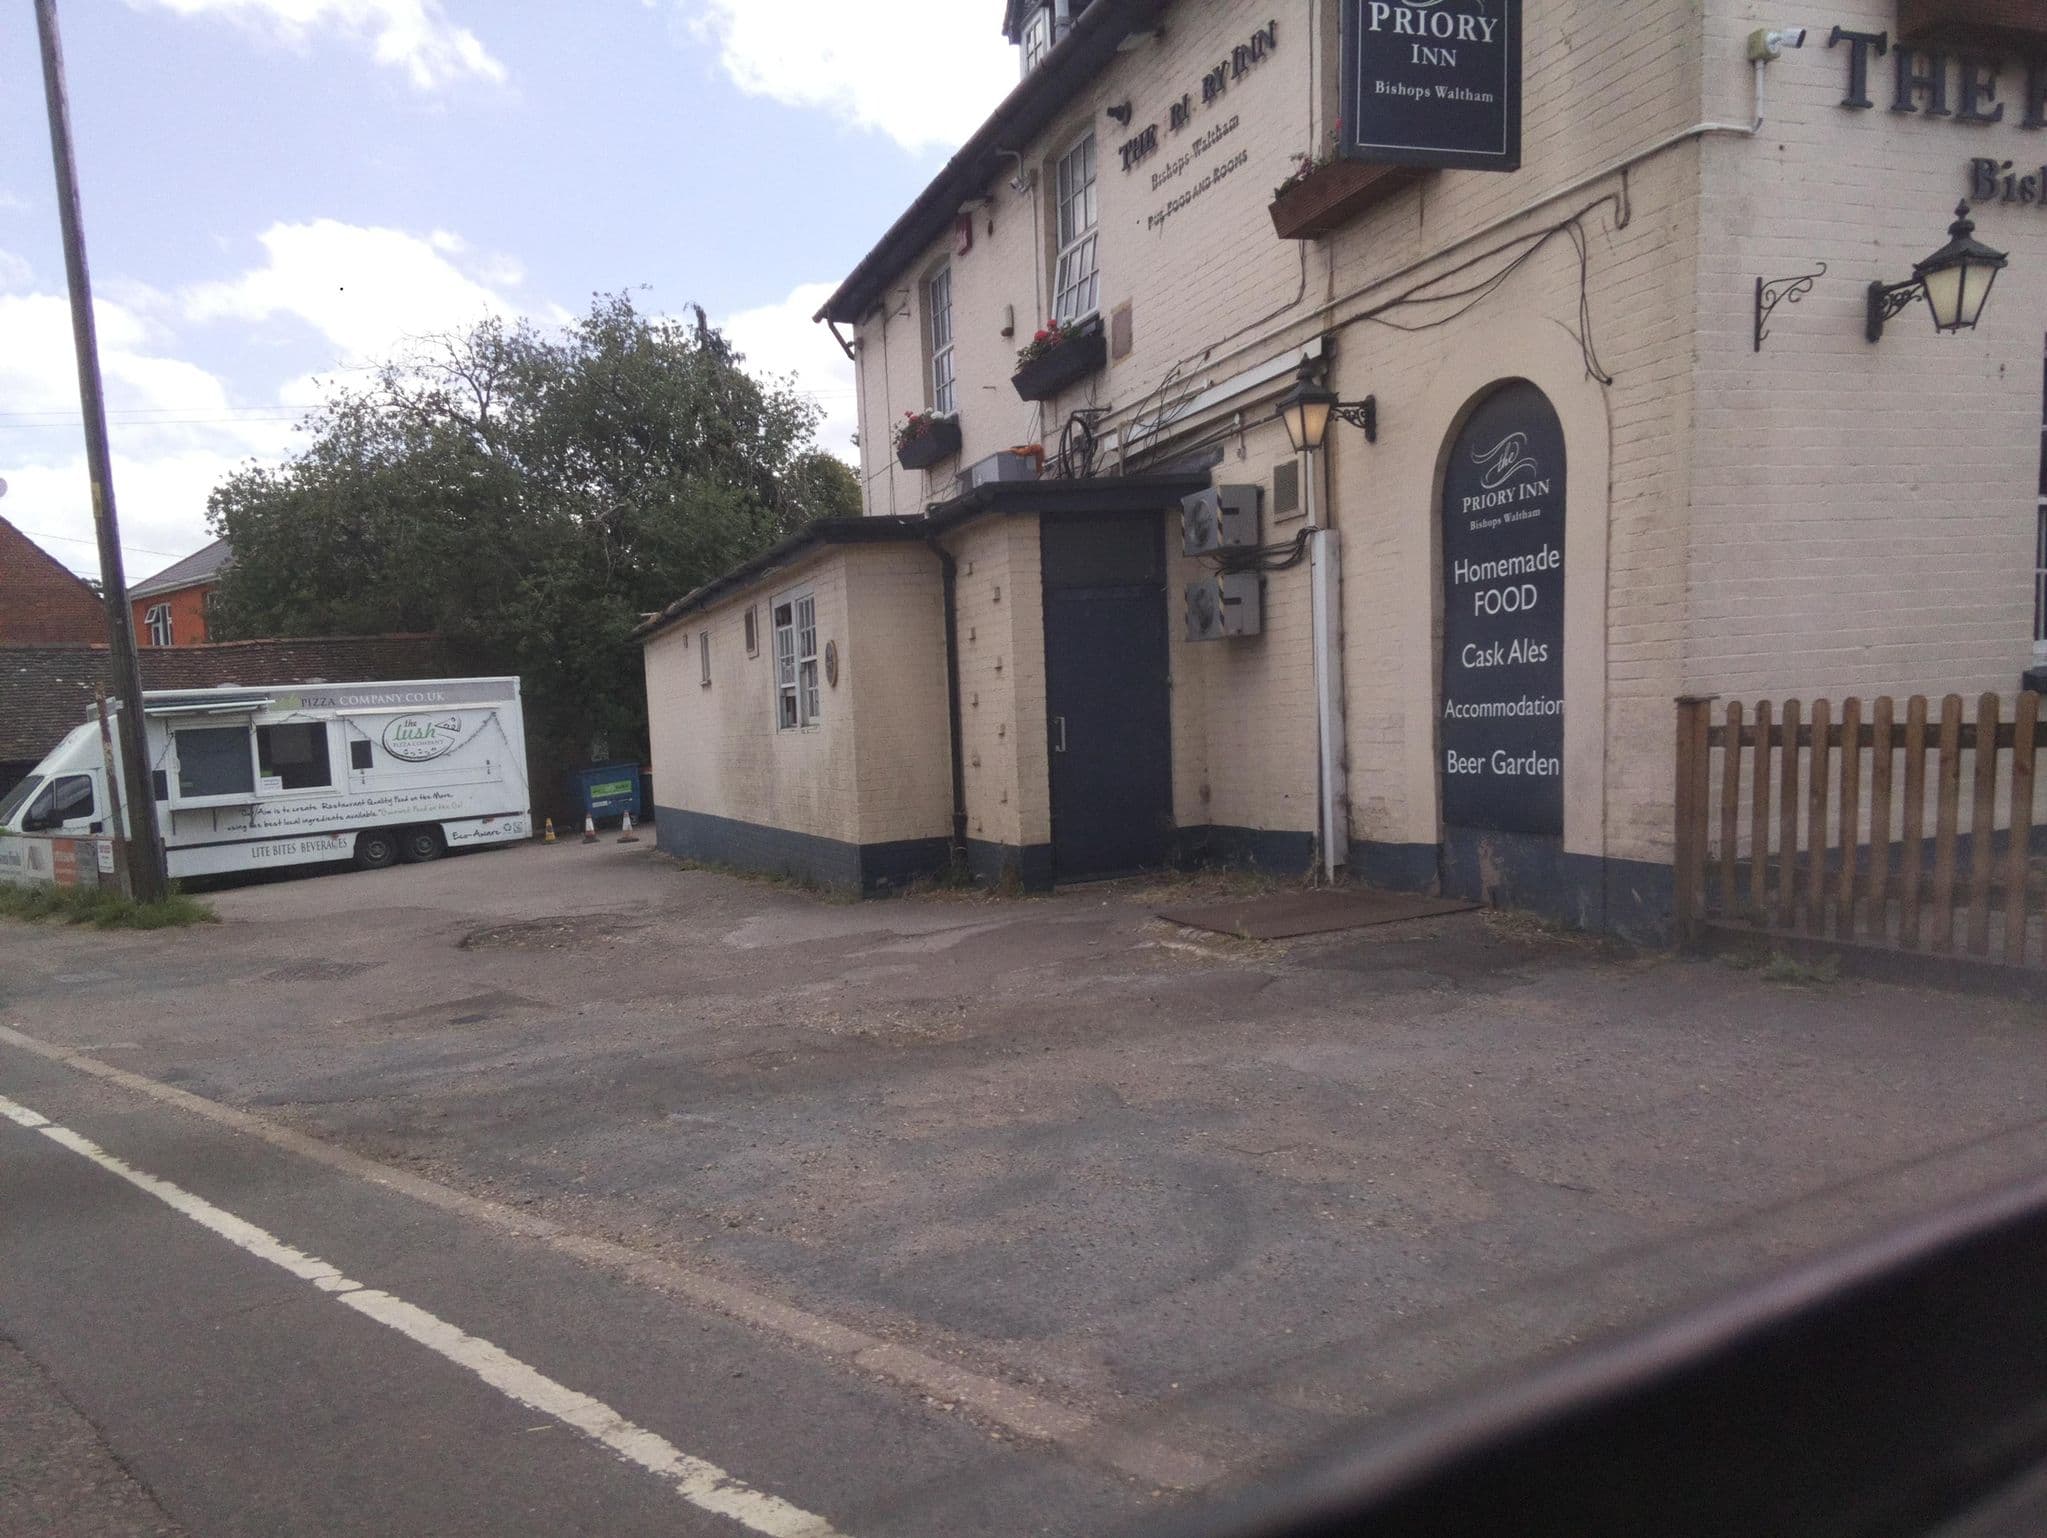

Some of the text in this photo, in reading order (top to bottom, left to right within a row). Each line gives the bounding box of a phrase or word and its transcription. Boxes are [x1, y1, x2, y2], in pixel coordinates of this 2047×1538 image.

[1368, 1, 1498, 43] PRIORY
[1411, 43, 1457, 67] INN
[1828, 25, 2004, 122] THE
[1119, 123, 1158, 171] THE
[1231, 19, 1277, 80] INN
[1375, 80, 1494, 103] Bishops Waltham
[1151, 115, 1239, 191] Bishops Waltham
[1167, 190, 1191, 217] FOOD
[1193, 176, 1211, 199] AND
[1213, 149, 1248, 184] ROOMS
[1462, 479, 1550, 513] PRIORY INN
[1470, 508, 1540, 531] Bishops Waltham
[1454, 543, 1560, 584] Homemade
[1475, 584, 1537, 616] FOOD
[1462, 638, 1548, 668] Cask Ales
[301, 697, 336, 708] PIZZA
[404, 719, 417, 727] the
[1447, 749, 1560, 776] Beer Garden
[256, 807, 272, 815] Aim
[292, 804, 317, 812] create
[322, 799, 365, 809] Restaurant
[367, 797, 392, 806] Quality
[227, 824, 247, 832] using
[263, 819, 281, 827] best
[284, 817, 300, 825] local
[302, 813, 344, 826] ingredients
[452, 829, 501, 840] Eco-Aware
[252, 846, 271, 858] LITE
[273, 843, 296, 856] BITES
